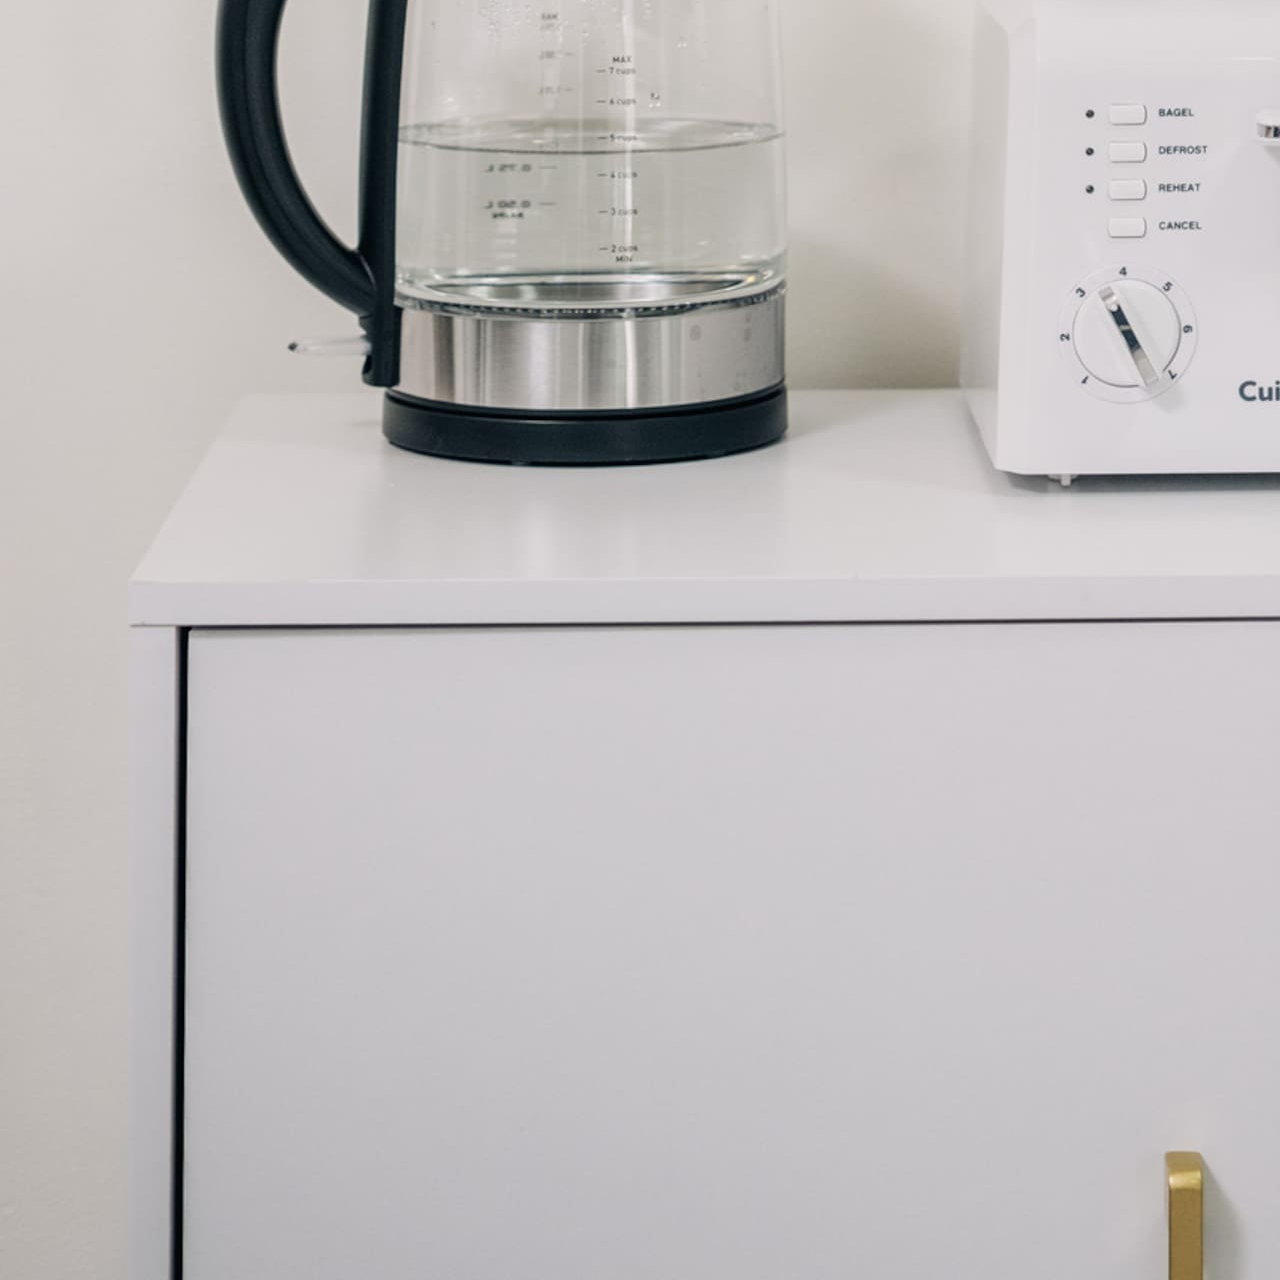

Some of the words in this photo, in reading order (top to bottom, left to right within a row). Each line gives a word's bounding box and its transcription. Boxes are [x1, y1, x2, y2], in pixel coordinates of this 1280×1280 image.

[612, 56, 632, 64] MAX
[1158, 108, 1195, 117] BAGEL
[1158, 145, 1208, 155] DEFROST
[1158, 183, 1201, 193] REHEAT
[1158, 221, 1203, 231] CANCEL
[615, 255, 633, 263] MIN
[1119, 266, 1128, 277] 4
[1162, 281, 1174, 292] 5
[1075, 287, 1087, 298] 3
[1182, 324, 1193, 334] 6
[1059, 332, 1071, 342] 2
[1167, 369, 1178, 380] 7
[1080, 375, 1090, 385] 1
